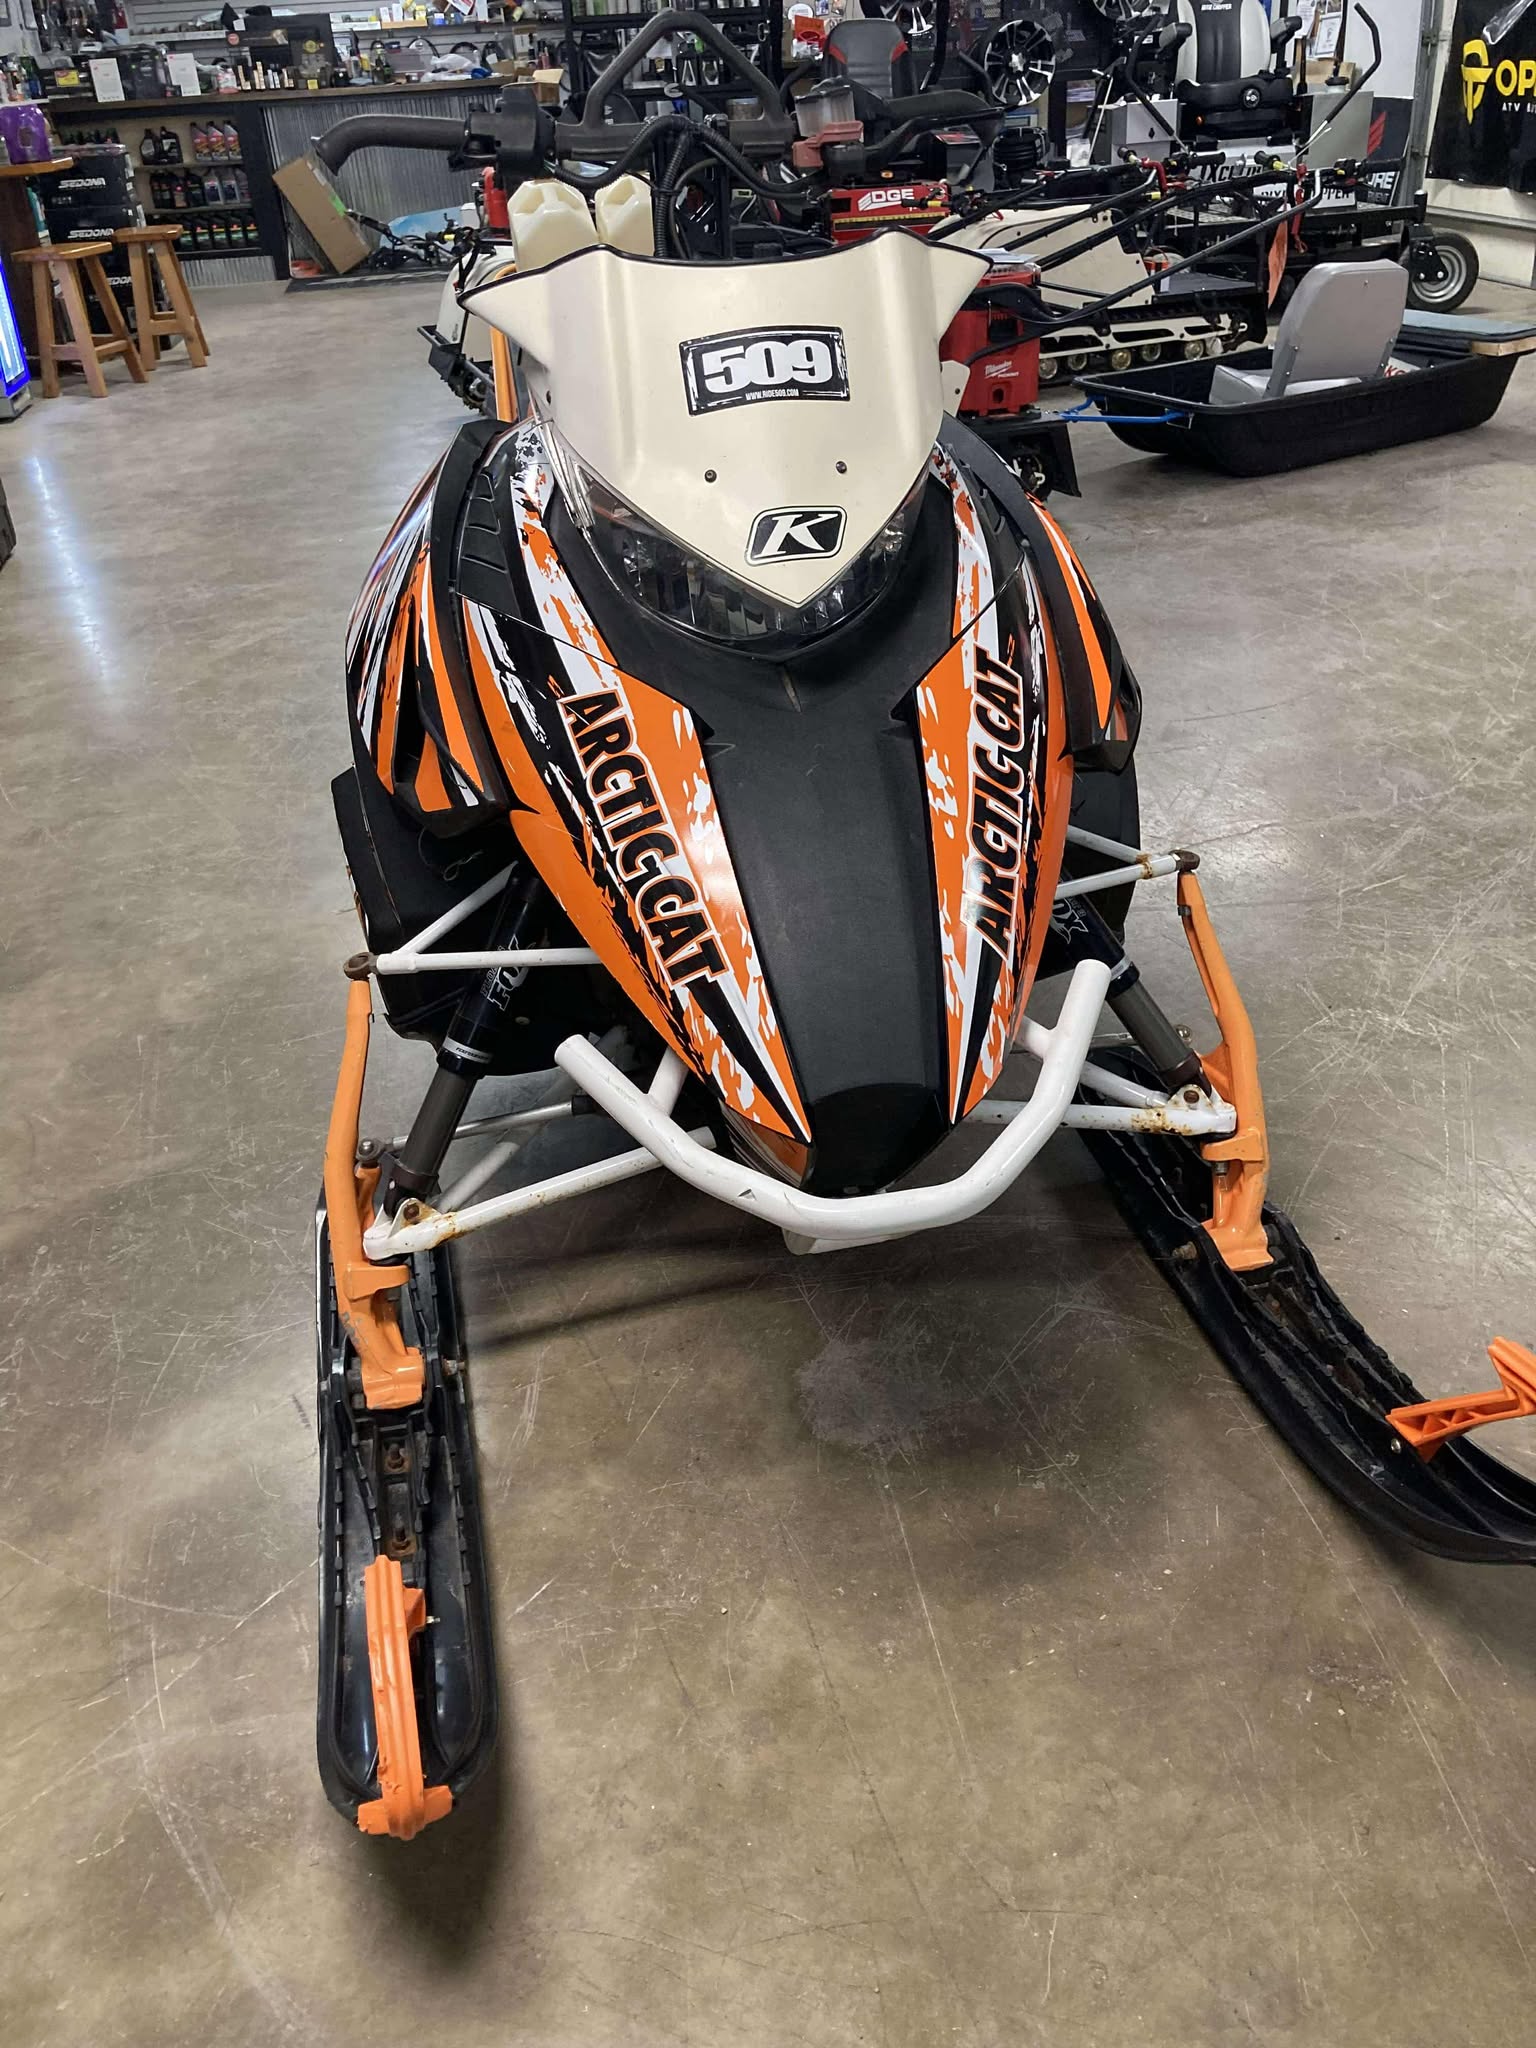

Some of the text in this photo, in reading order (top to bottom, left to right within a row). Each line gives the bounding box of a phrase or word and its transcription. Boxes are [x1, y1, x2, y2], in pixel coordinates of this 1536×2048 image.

[1495, 59, 1536, 96] OP
[1502, 102, 1520, 112] ATV
[58, 177, 106, 189] SEDONA
[106, 275, 132, 286] EDON
[701, 339, 833, 393] 509
[960, 643, 1024, 962] ARCTIC CAT
[559, 689, 730, 986] ARCTIC CAT
